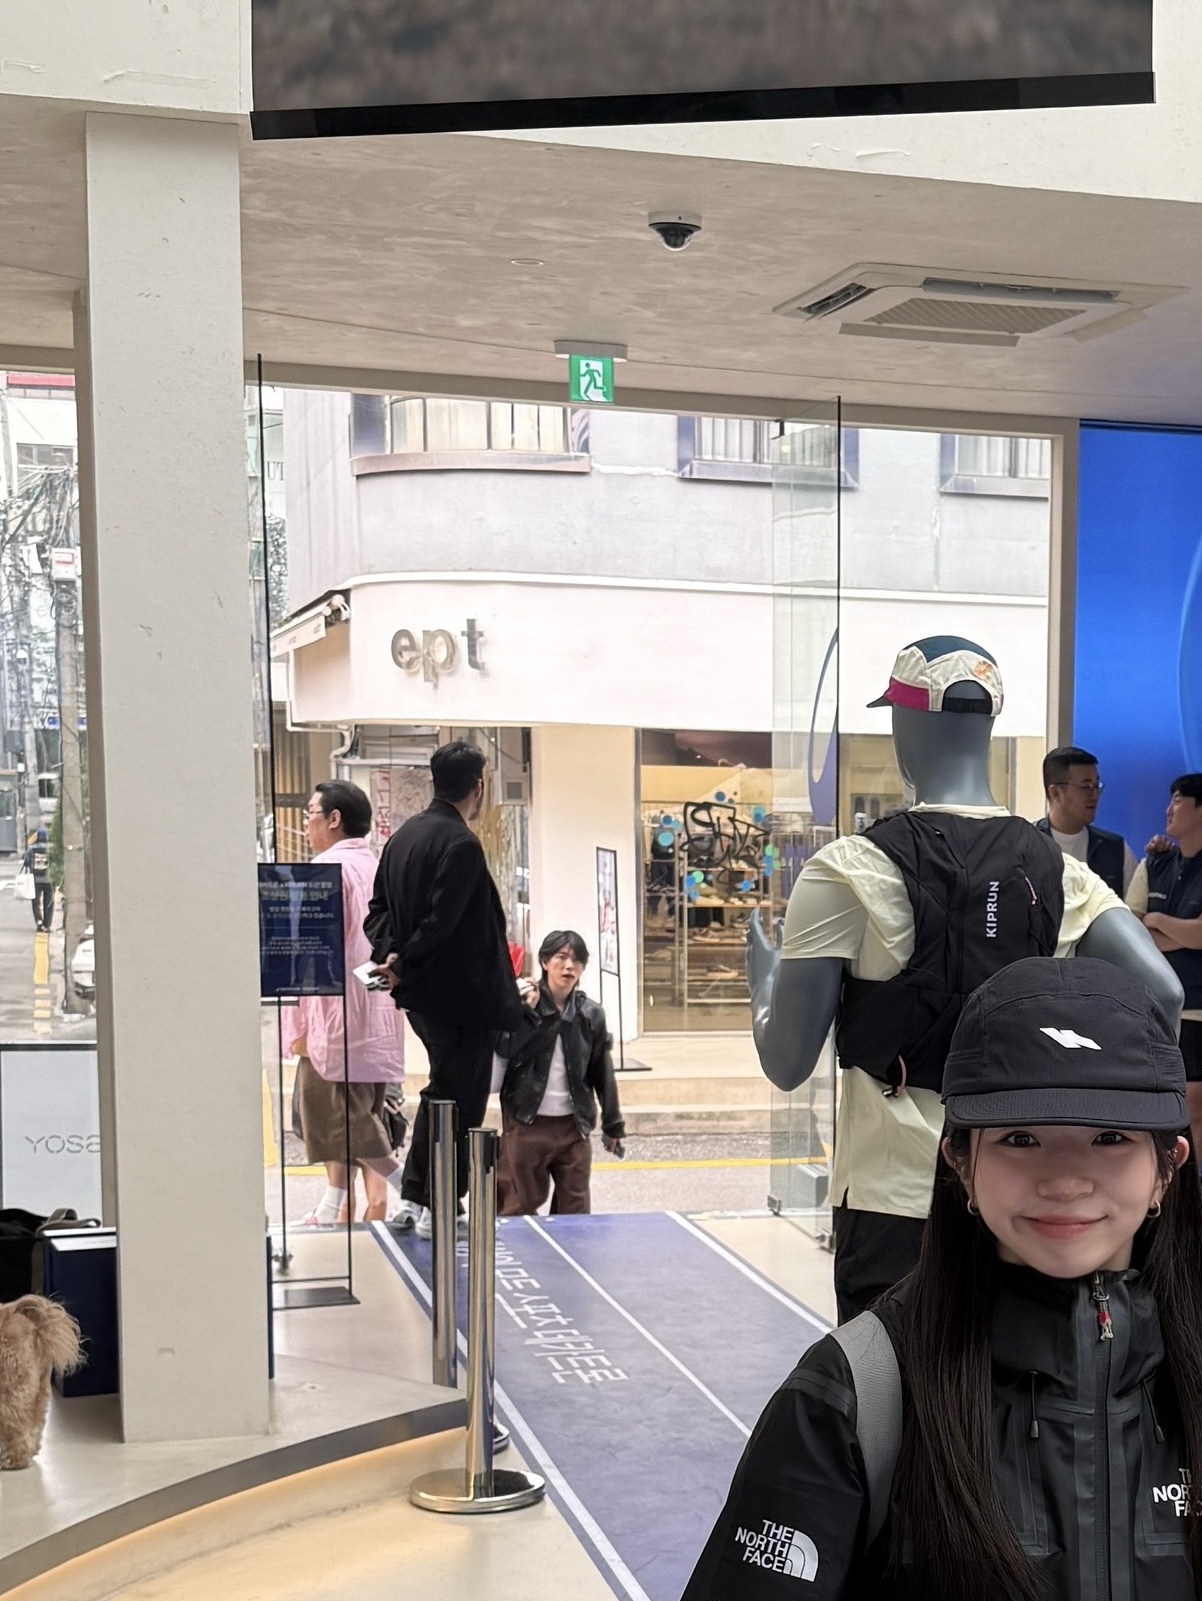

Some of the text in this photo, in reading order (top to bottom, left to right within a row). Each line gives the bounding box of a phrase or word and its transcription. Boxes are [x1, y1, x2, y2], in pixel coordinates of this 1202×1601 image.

[391, 618, 485, 685] ept
[986, 881, 1000, 938] KIPRUN
[1152, 1483, 1192, 1503] NOR
[735, 1526, 790, 1557] NORTH
[762, 1519, 794, 1543] THE
[742, 1546, 785, 1573] FACE
